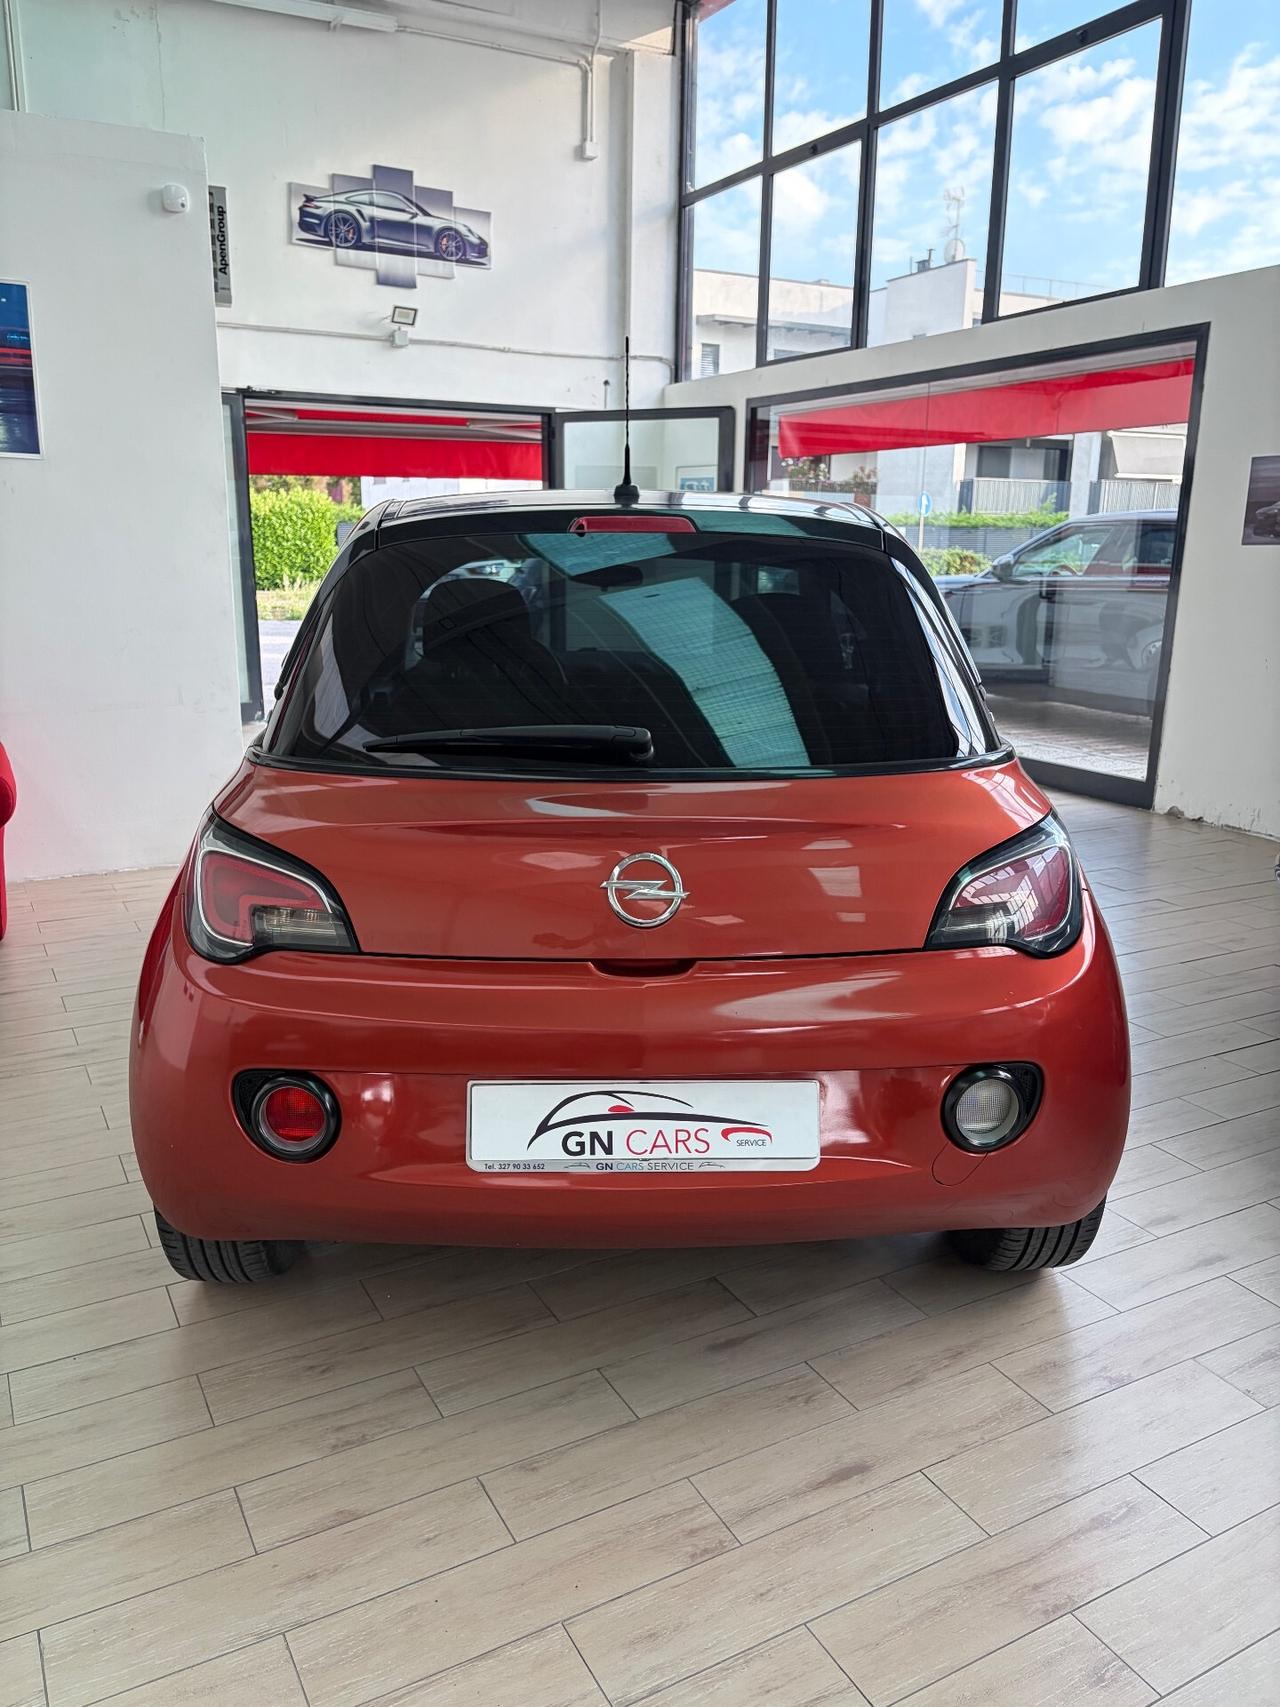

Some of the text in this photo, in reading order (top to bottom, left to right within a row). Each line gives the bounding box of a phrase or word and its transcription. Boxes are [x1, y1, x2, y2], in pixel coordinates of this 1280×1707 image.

[217, 205, 229, 276] ApenGroup
[561, 1128, 710, 1157] GN CARS
[736, 1139, 767, 1147] SERVICE
[595, 1162, 694, 1171] GN CARS SERVICE
